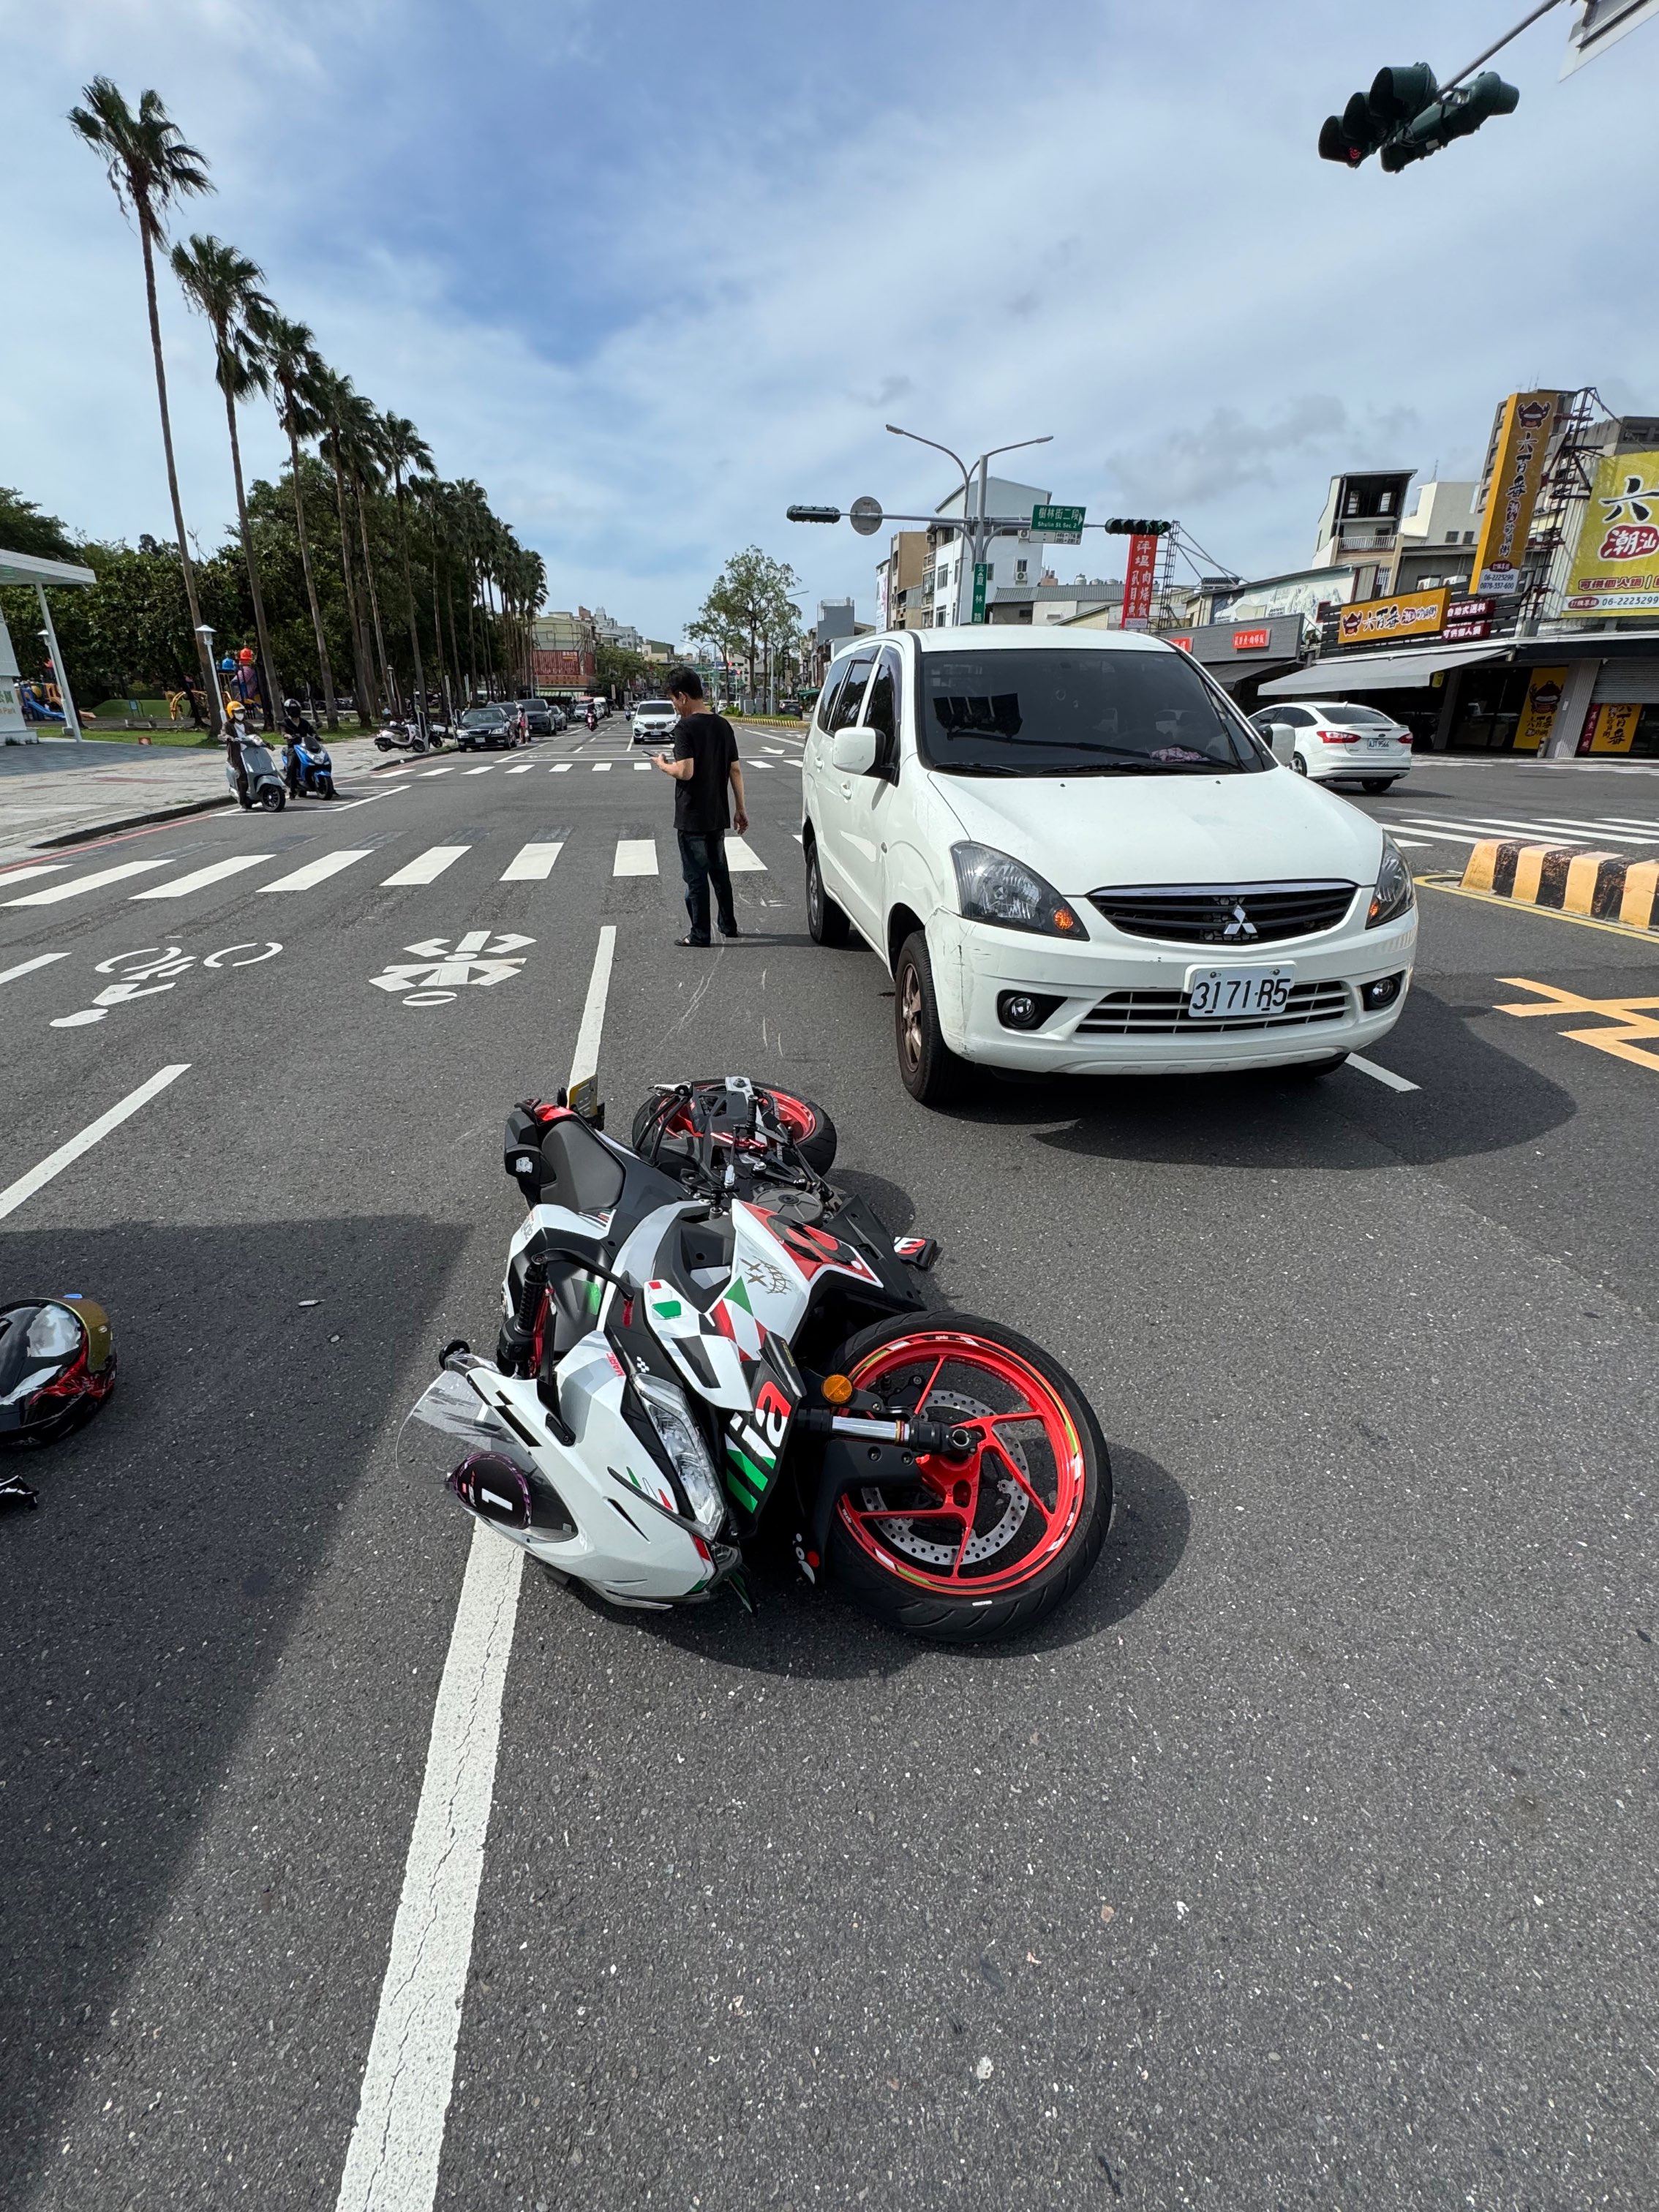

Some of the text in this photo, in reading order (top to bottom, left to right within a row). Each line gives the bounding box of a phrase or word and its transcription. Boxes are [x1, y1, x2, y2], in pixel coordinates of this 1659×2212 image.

[1039, 507, 1080, 520] 樹林街二段
[1603, 530, 1657, 559] 潮汕
[974, 576, 984, 622] 夏林路
[1602, 596, 1659, 606] 06-2223299
